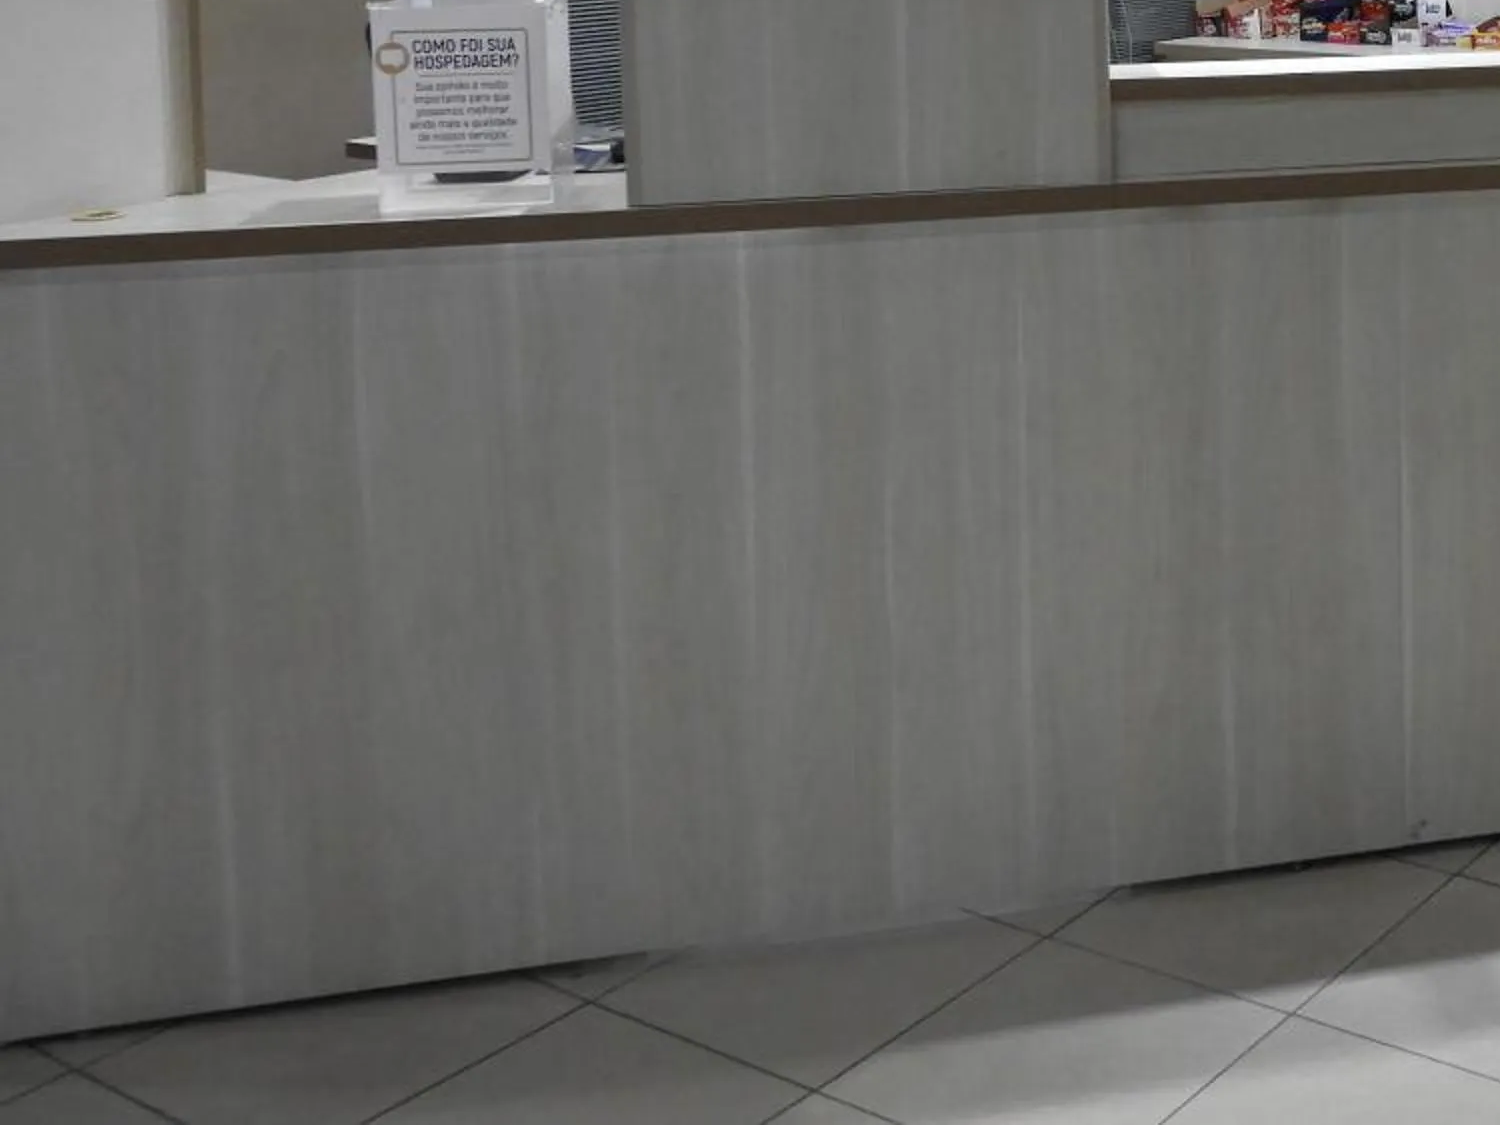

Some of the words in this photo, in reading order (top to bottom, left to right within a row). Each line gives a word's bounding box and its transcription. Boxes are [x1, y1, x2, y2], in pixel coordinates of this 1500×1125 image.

[412, 39, 456, 54] COMO
[460, 38, 482, 52] FOI
[487, 37, 516, 52] SUA
[414, 54, 519, 69] HOSPEDAGEM?
